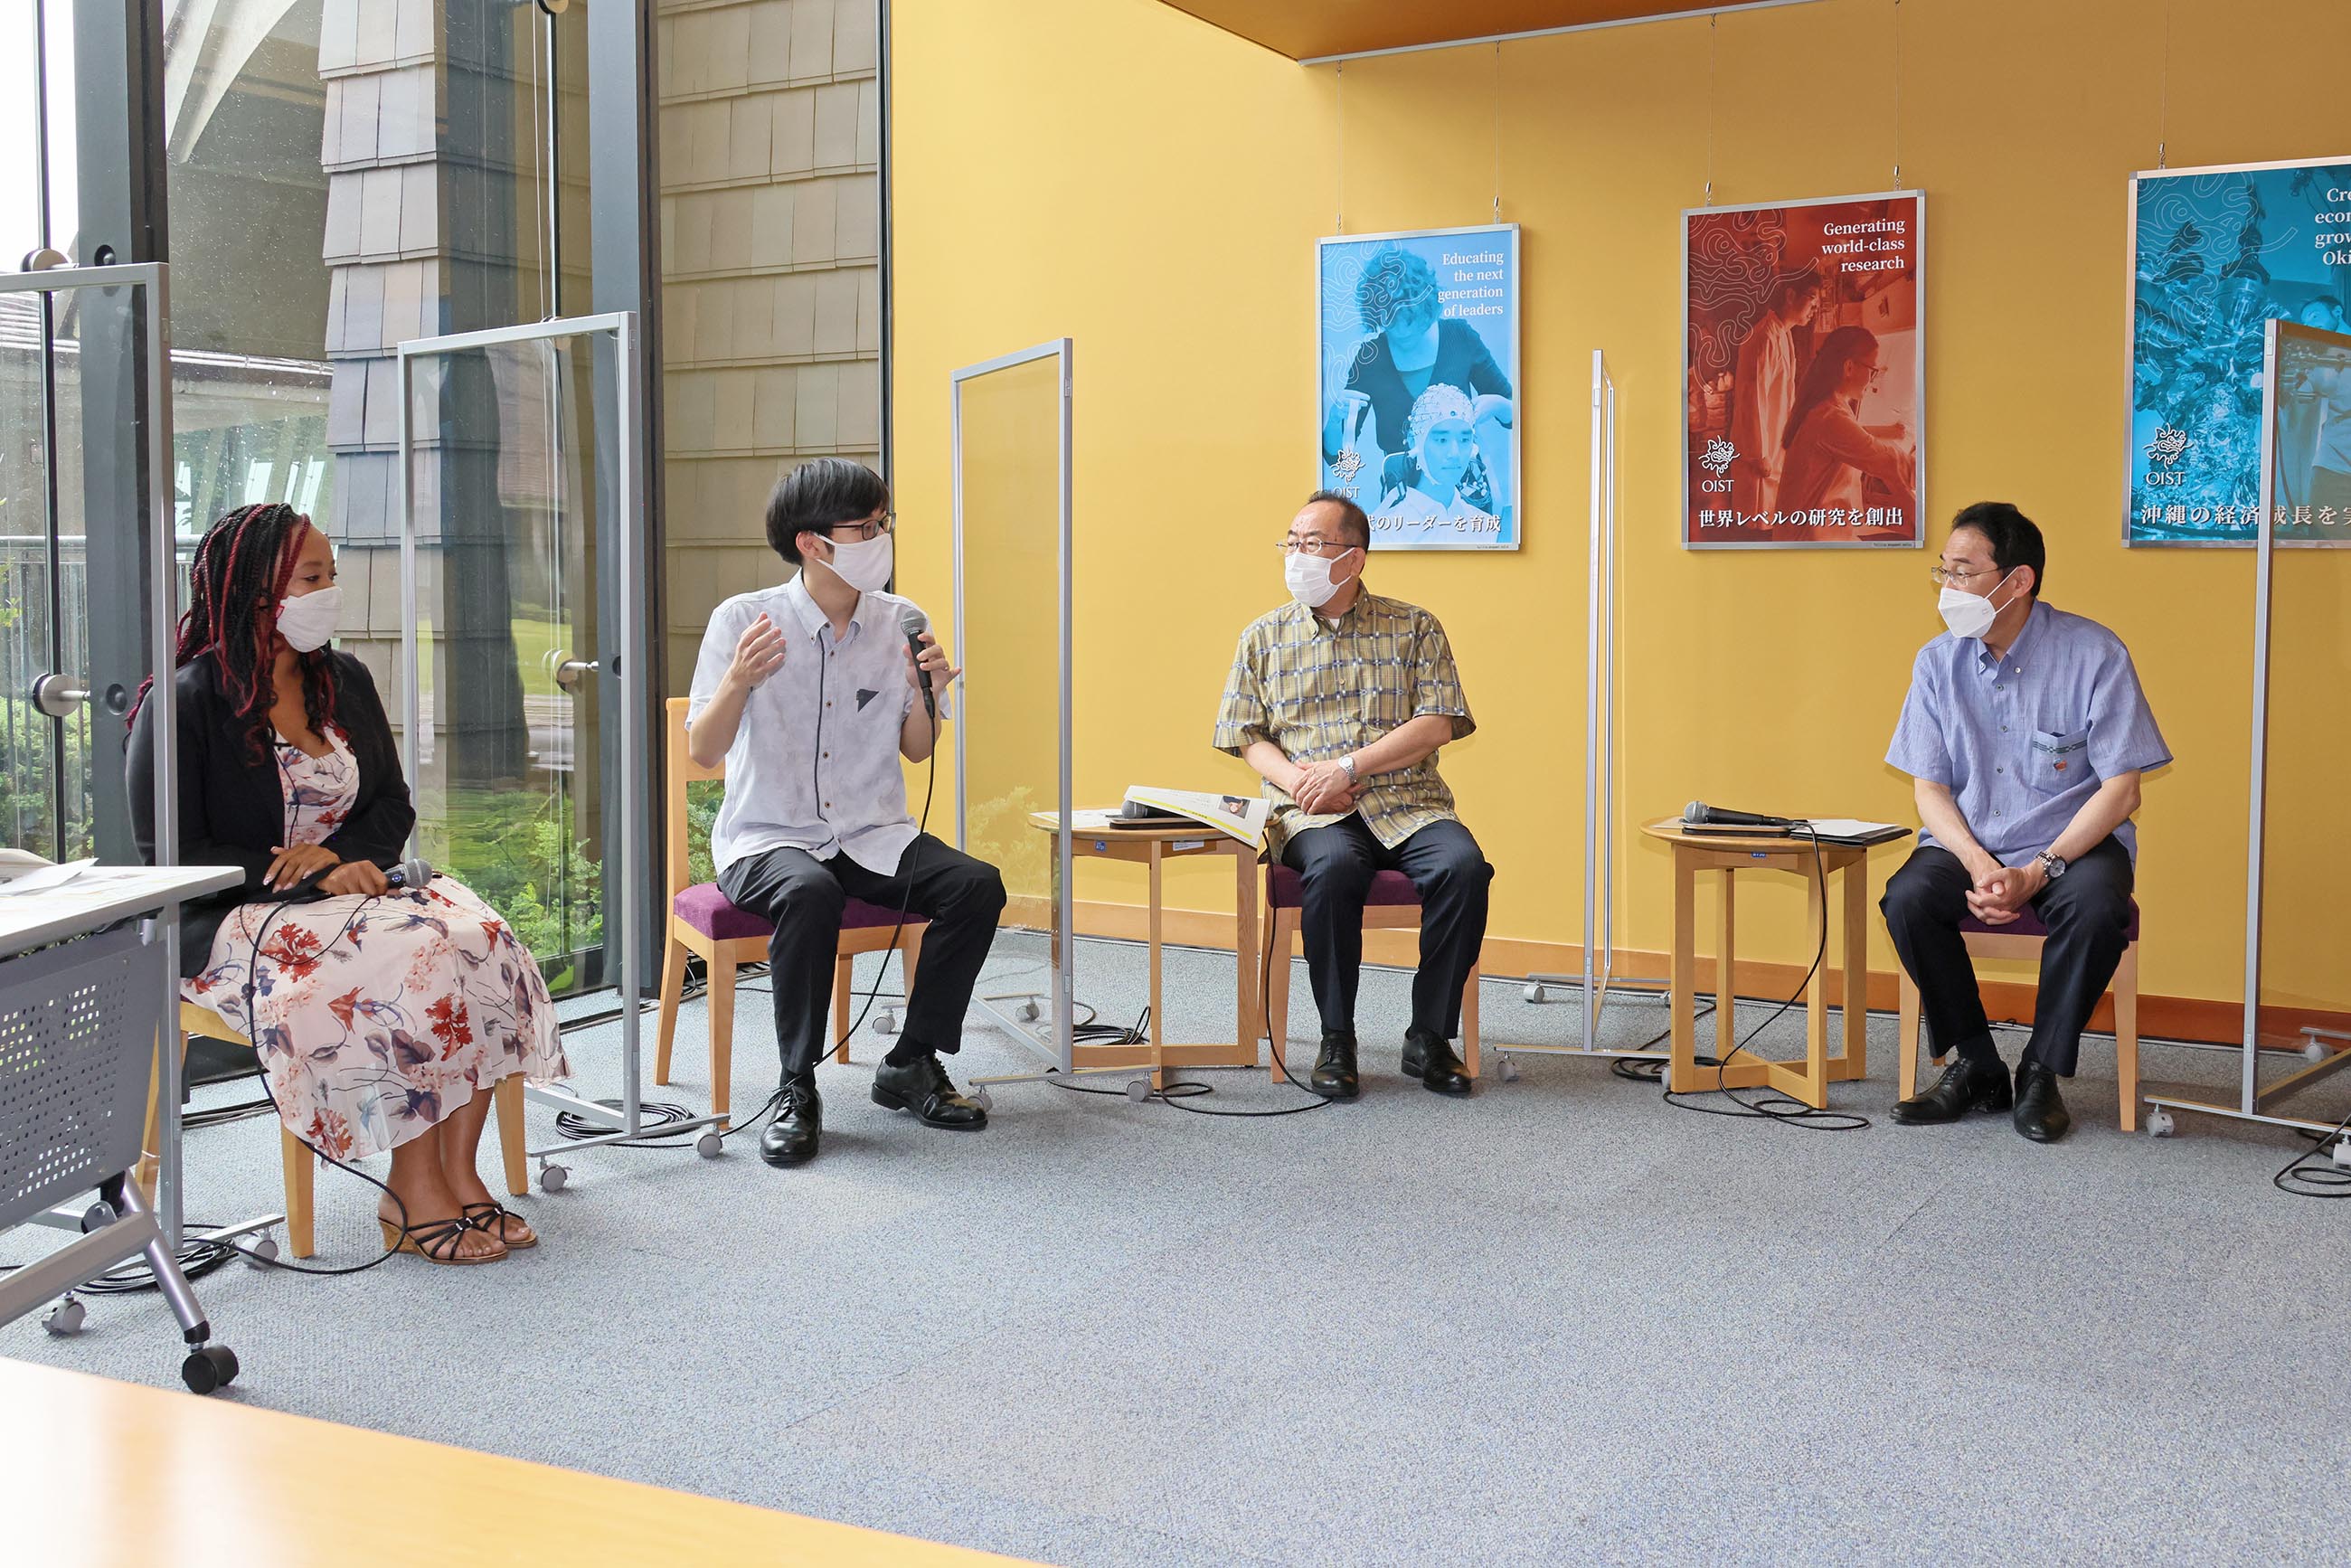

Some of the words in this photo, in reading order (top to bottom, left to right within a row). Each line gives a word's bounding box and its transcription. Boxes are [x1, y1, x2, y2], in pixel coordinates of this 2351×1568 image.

[1824, 218, 1905, 235] Generating
[1821, 237, 1905, 254] world-class
[1442, 250, 1504, 266] Educating
[1841, 256, 1905, 272] research
[1454, 269, 1474, 282] the
[1477, 269, 1504, 280] next
[1438, 286, 1503, 303] generation
[1444, 304, 1458, 316] of
[1459, 303, 1504, 316] leaders
[1701, 479, 1734, 493] OIST
[2146, 471, 2185, 486] OIST
[1698, 507, 1903, 528] 世界レベルの研究を創出
